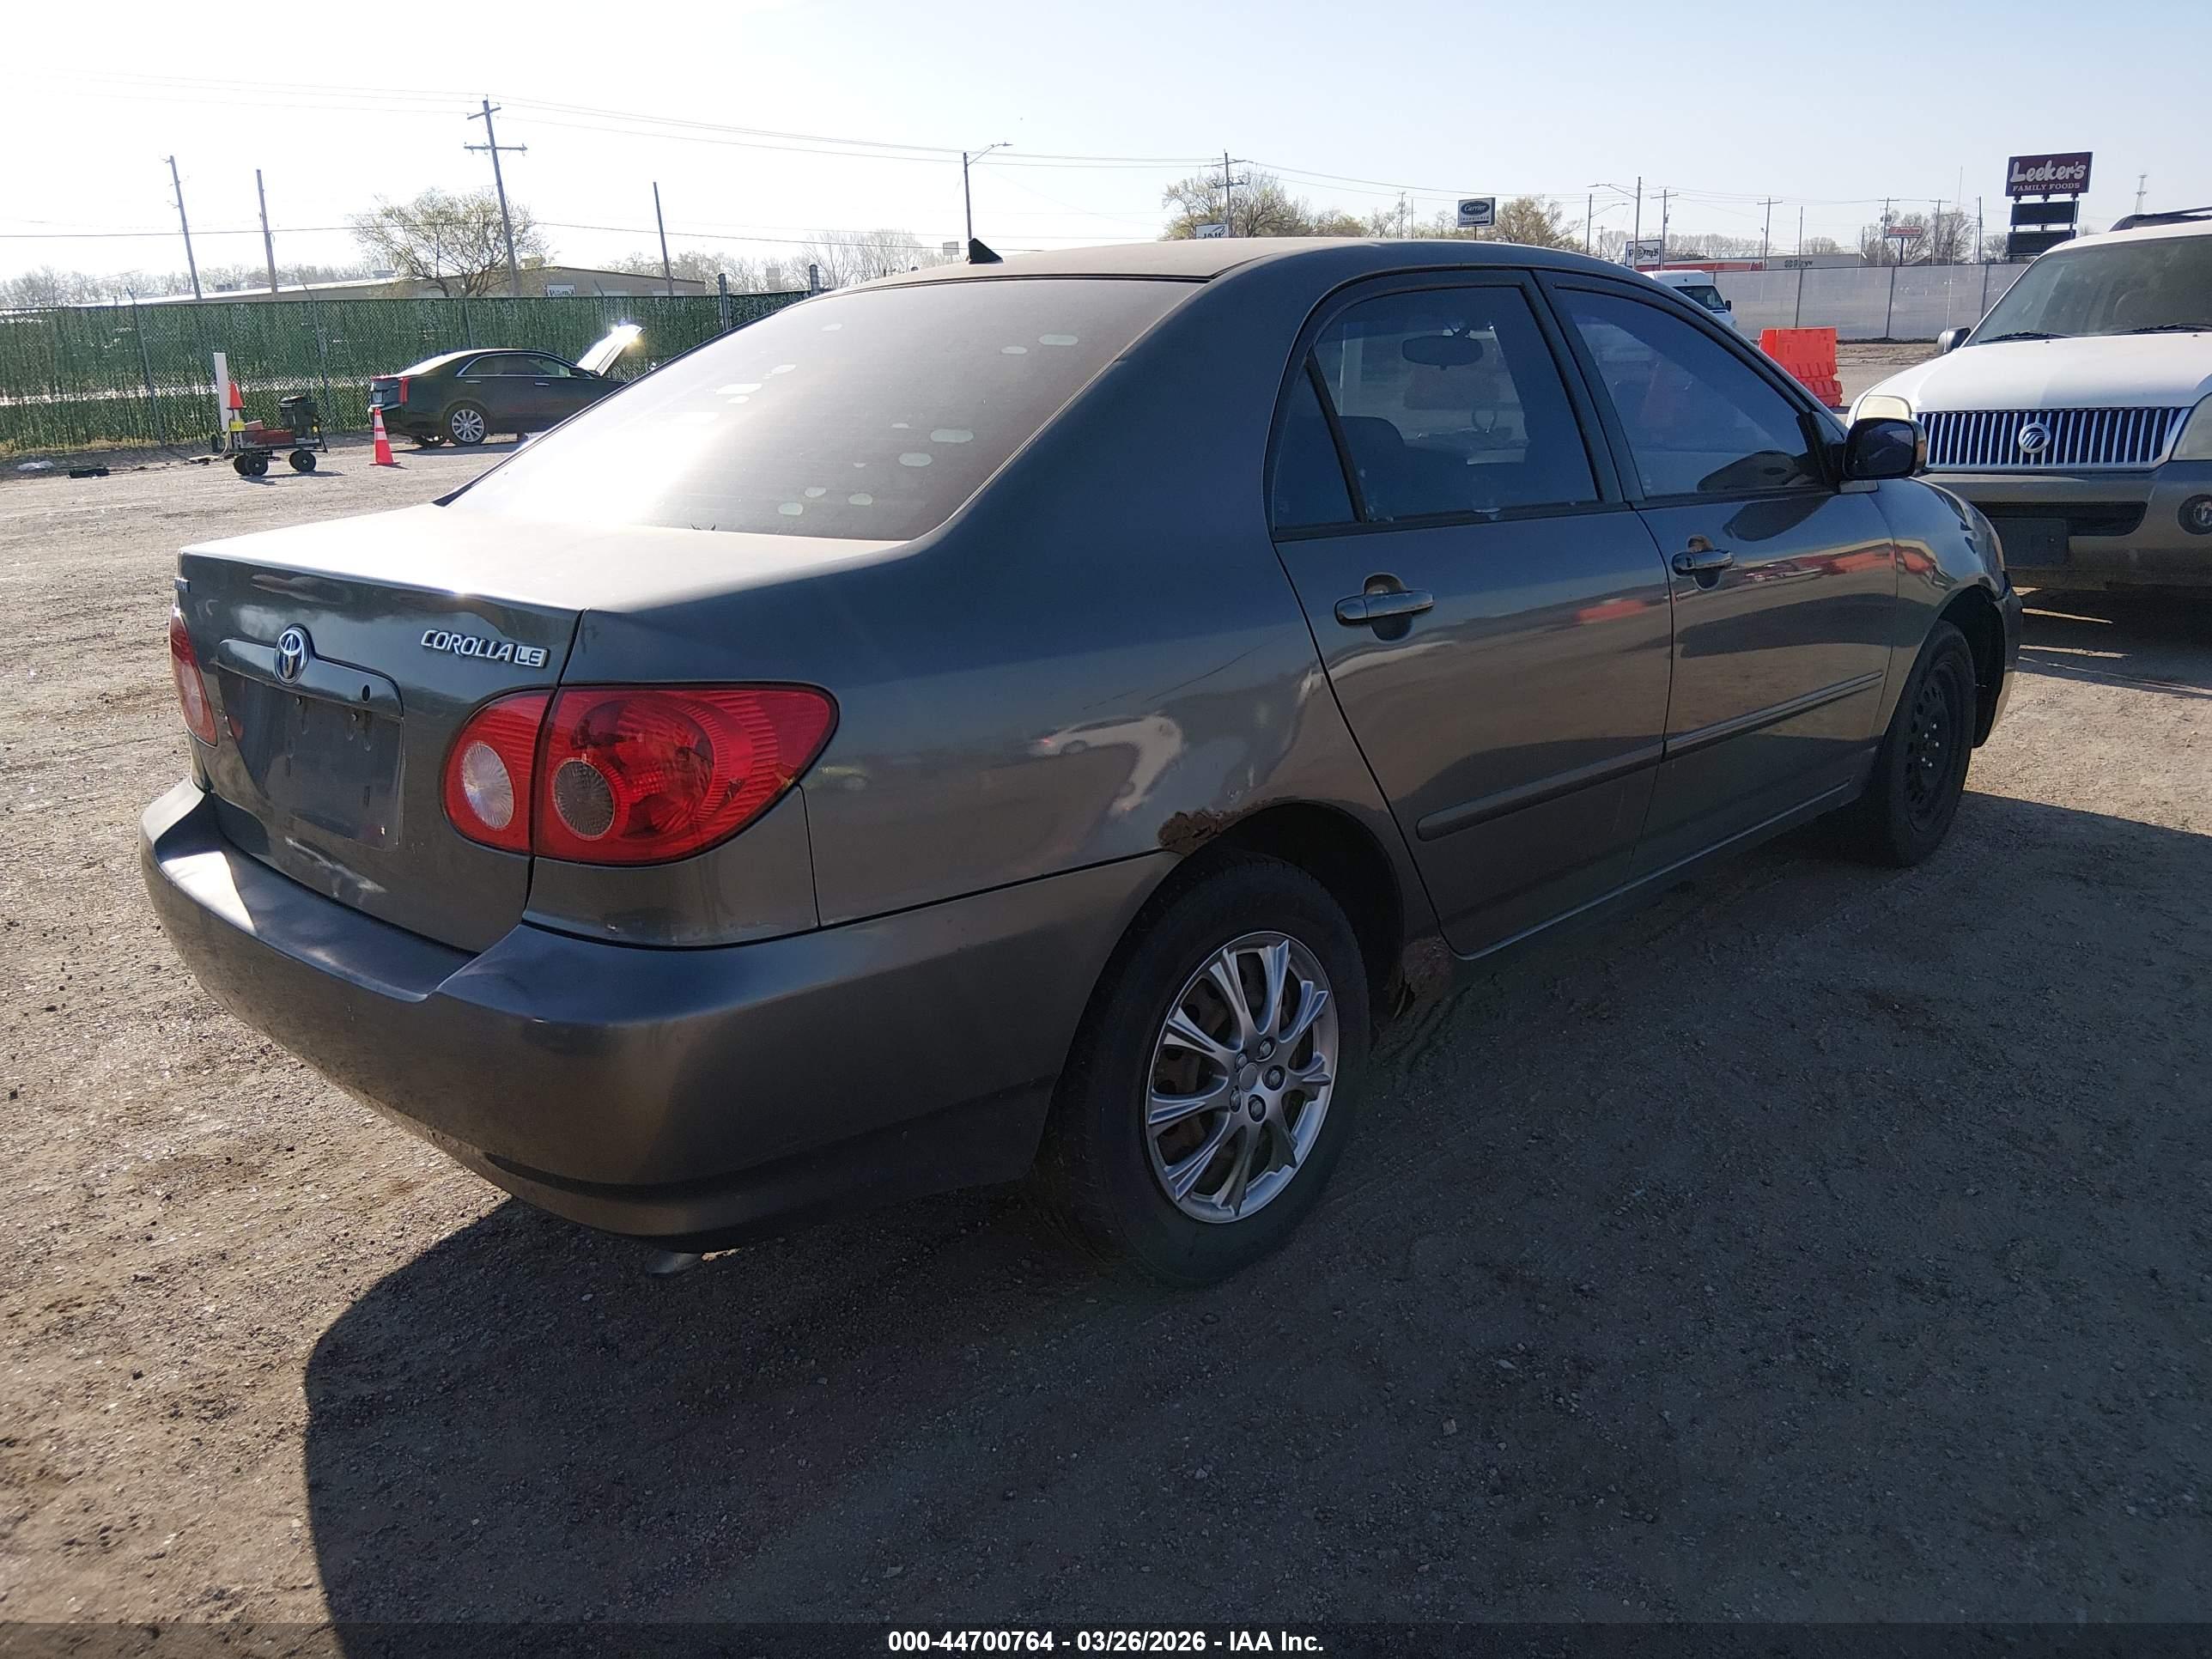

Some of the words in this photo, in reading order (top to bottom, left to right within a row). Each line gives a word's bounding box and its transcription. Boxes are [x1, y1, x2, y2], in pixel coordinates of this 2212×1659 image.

[2010, 160, 2087, 182] Leeker's
[421, 629, 514, 661] COROLLA
[515, 646, 545, 666] LE
